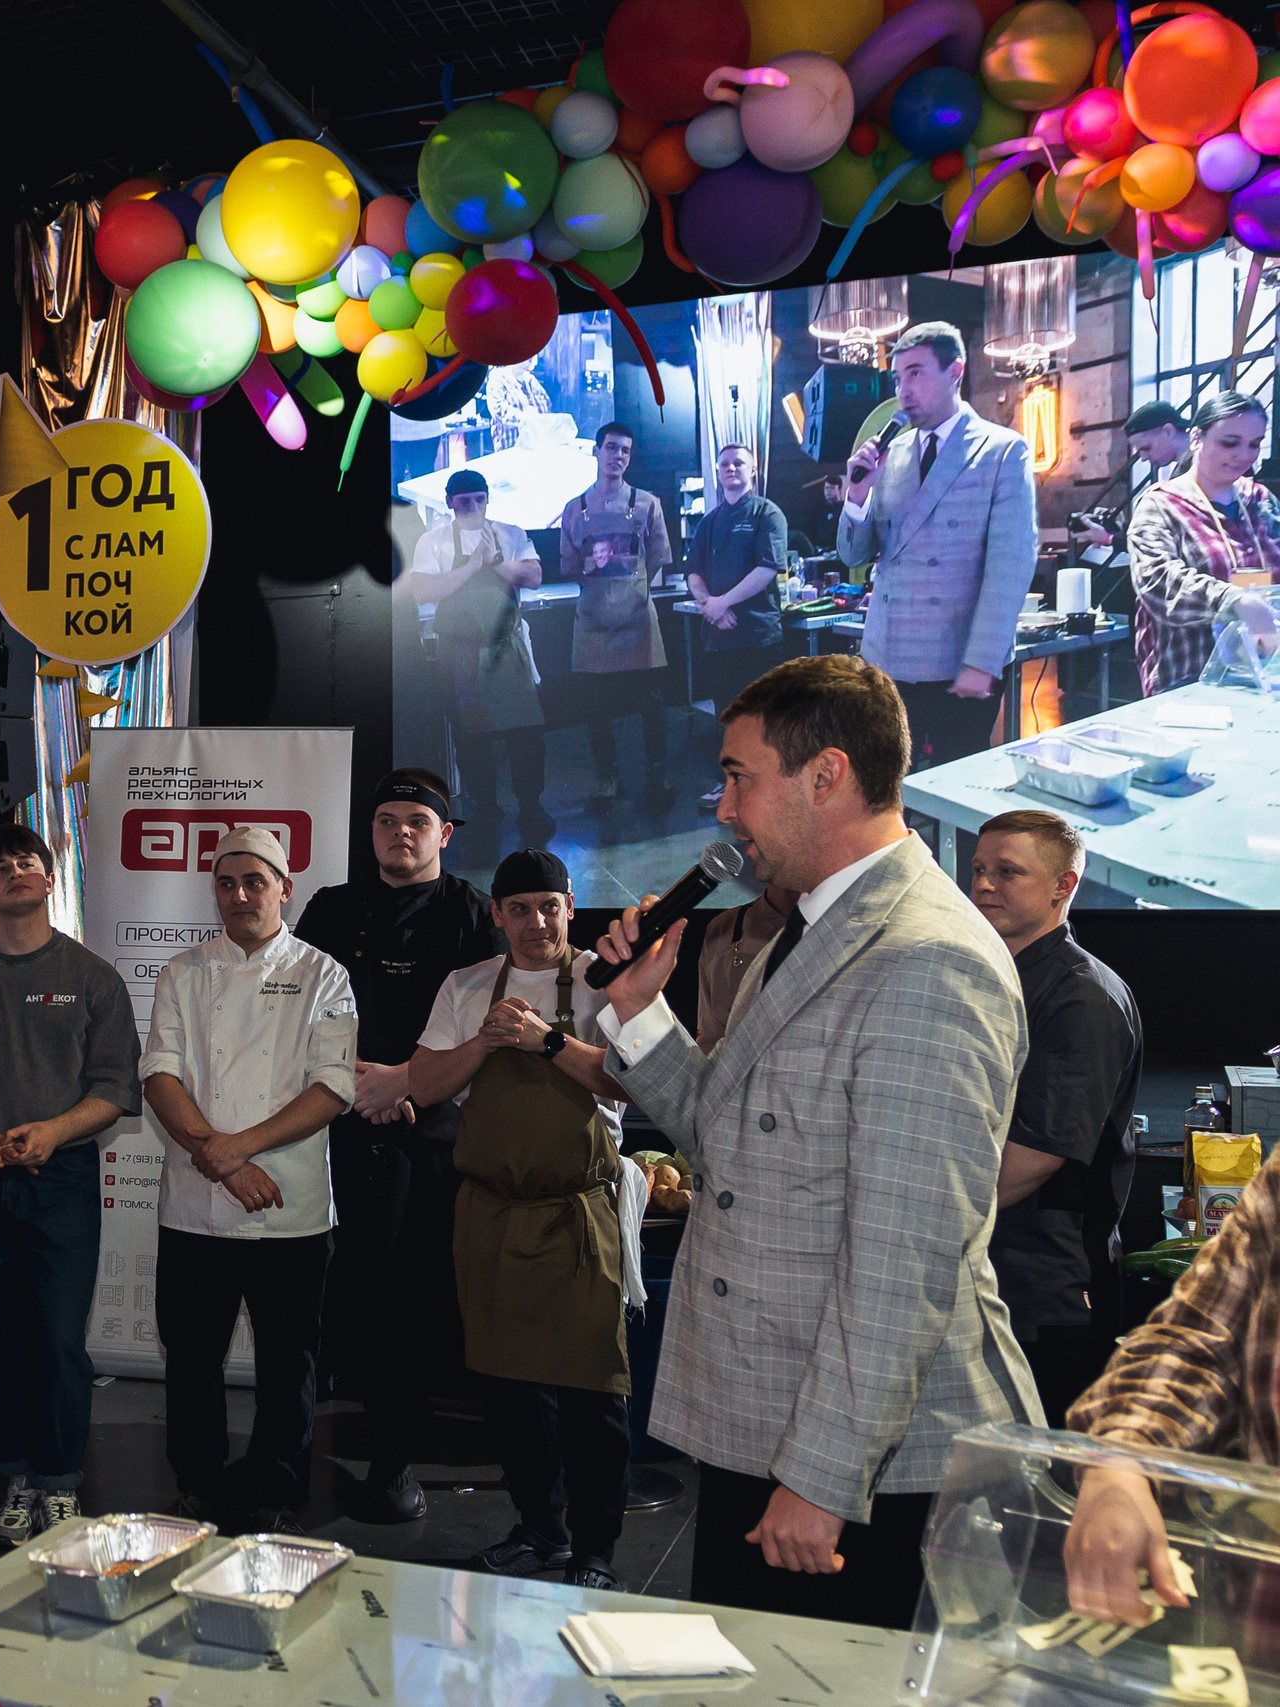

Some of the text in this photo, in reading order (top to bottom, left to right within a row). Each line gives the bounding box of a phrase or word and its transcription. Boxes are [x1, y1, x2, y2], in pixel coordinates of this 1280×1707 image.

[7, 460, 175, 592] 1 ГОД
[65, 529, 164, 561] С ЛАМ
[66, 570, 131, 598] ПОЧ
[65, 602, 131, 637] КОЙ
[128, 766, 198, 777] альянс
[127, 778, 264, 793] ресторанных
[127, 790, 247, 801] технологий
[132, 1155, 153, 1165] (913)
[119, 1199, 154, 1211] ТОМСК,
